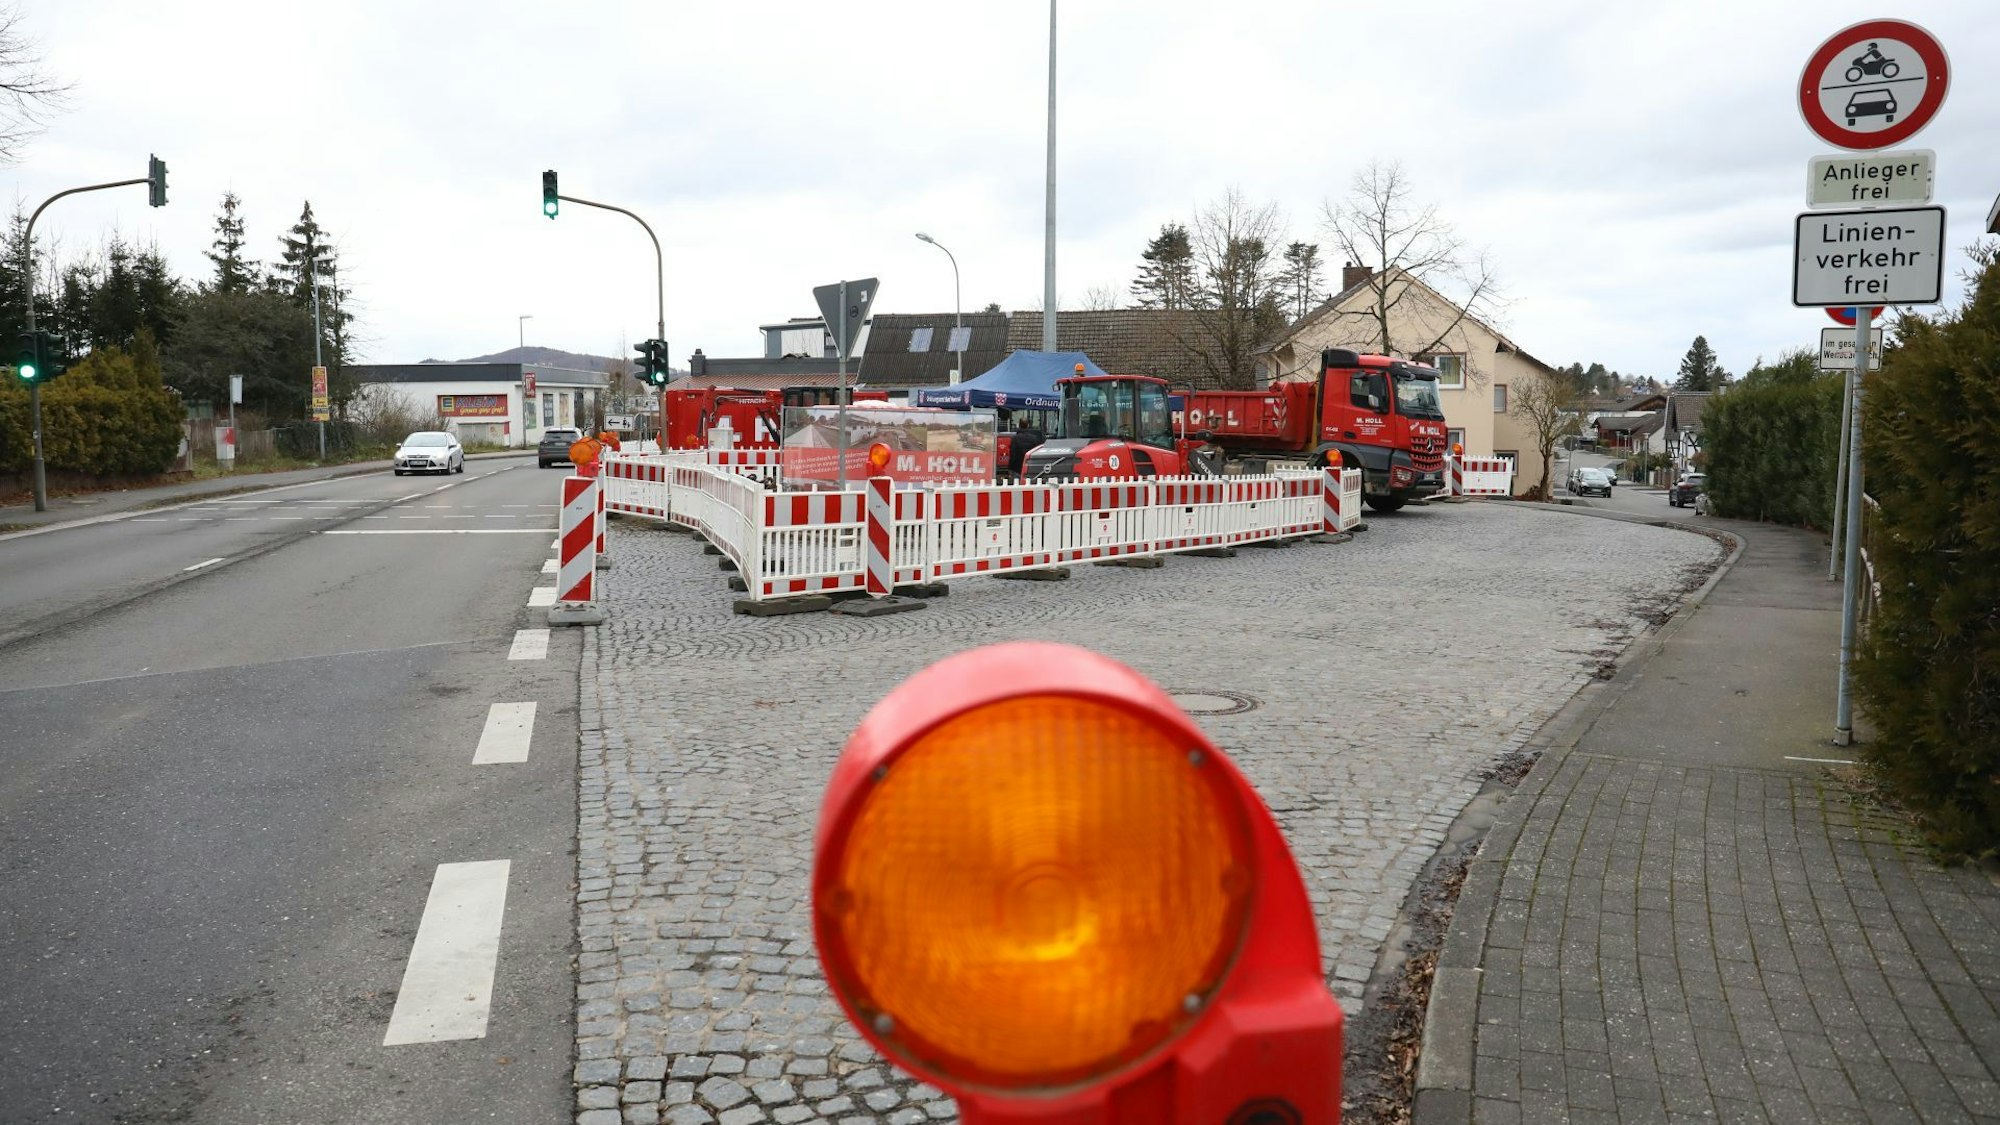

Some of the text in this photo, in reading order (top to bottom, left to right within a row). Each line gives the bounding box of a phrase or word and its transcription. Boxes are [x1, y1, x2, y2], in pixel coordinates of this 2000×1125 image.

[1823, 161, 1920, 182] Anlieger
[1851, 182, 1889, 200] frei
[1822, 221, 1915, 243] Linien-
[1816, 247, 1921, 269] verkehr
[1845, 274, 1888, 294] frei
[896, 454, 986, 473] M. HOLL
